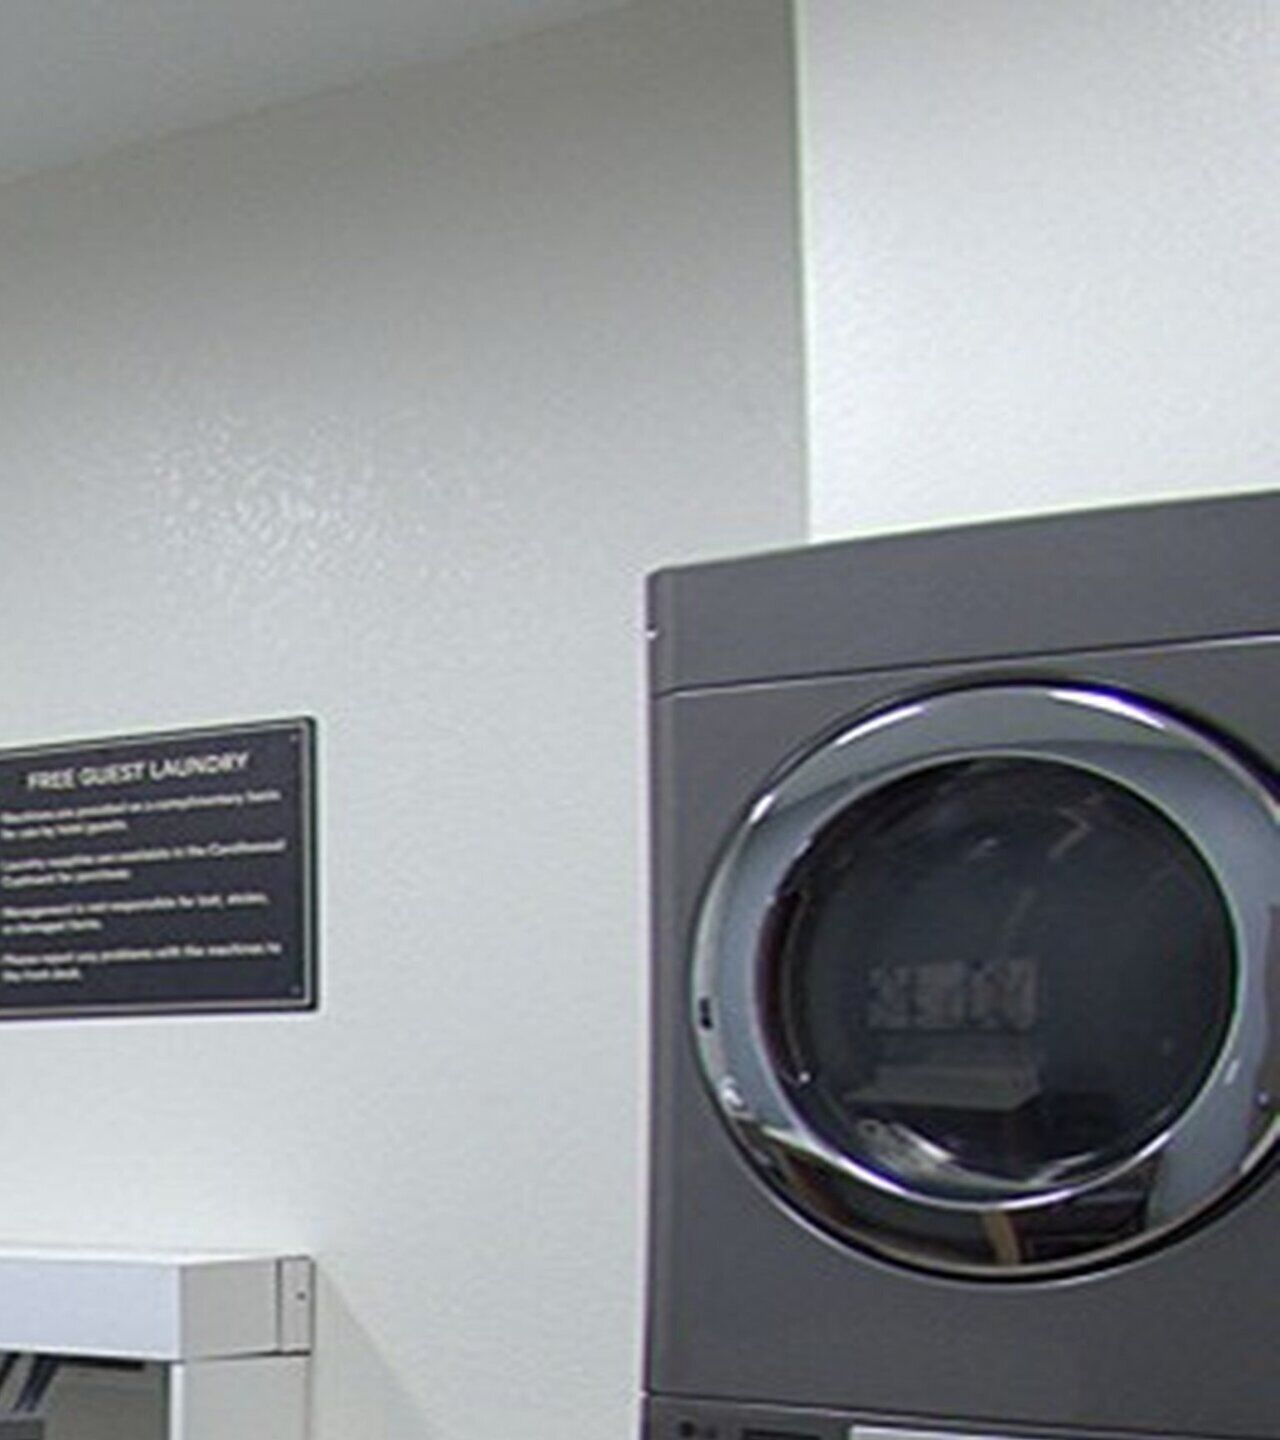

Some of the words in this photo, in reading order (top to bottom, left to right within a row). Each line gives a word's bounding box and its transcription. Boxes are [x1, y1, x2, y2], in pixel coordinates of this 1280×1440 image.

[27, 768, 76, 791] FREE
[79, 760, 145, 786] GUEST
[149, 752, 249, 780] LAUNDRY
